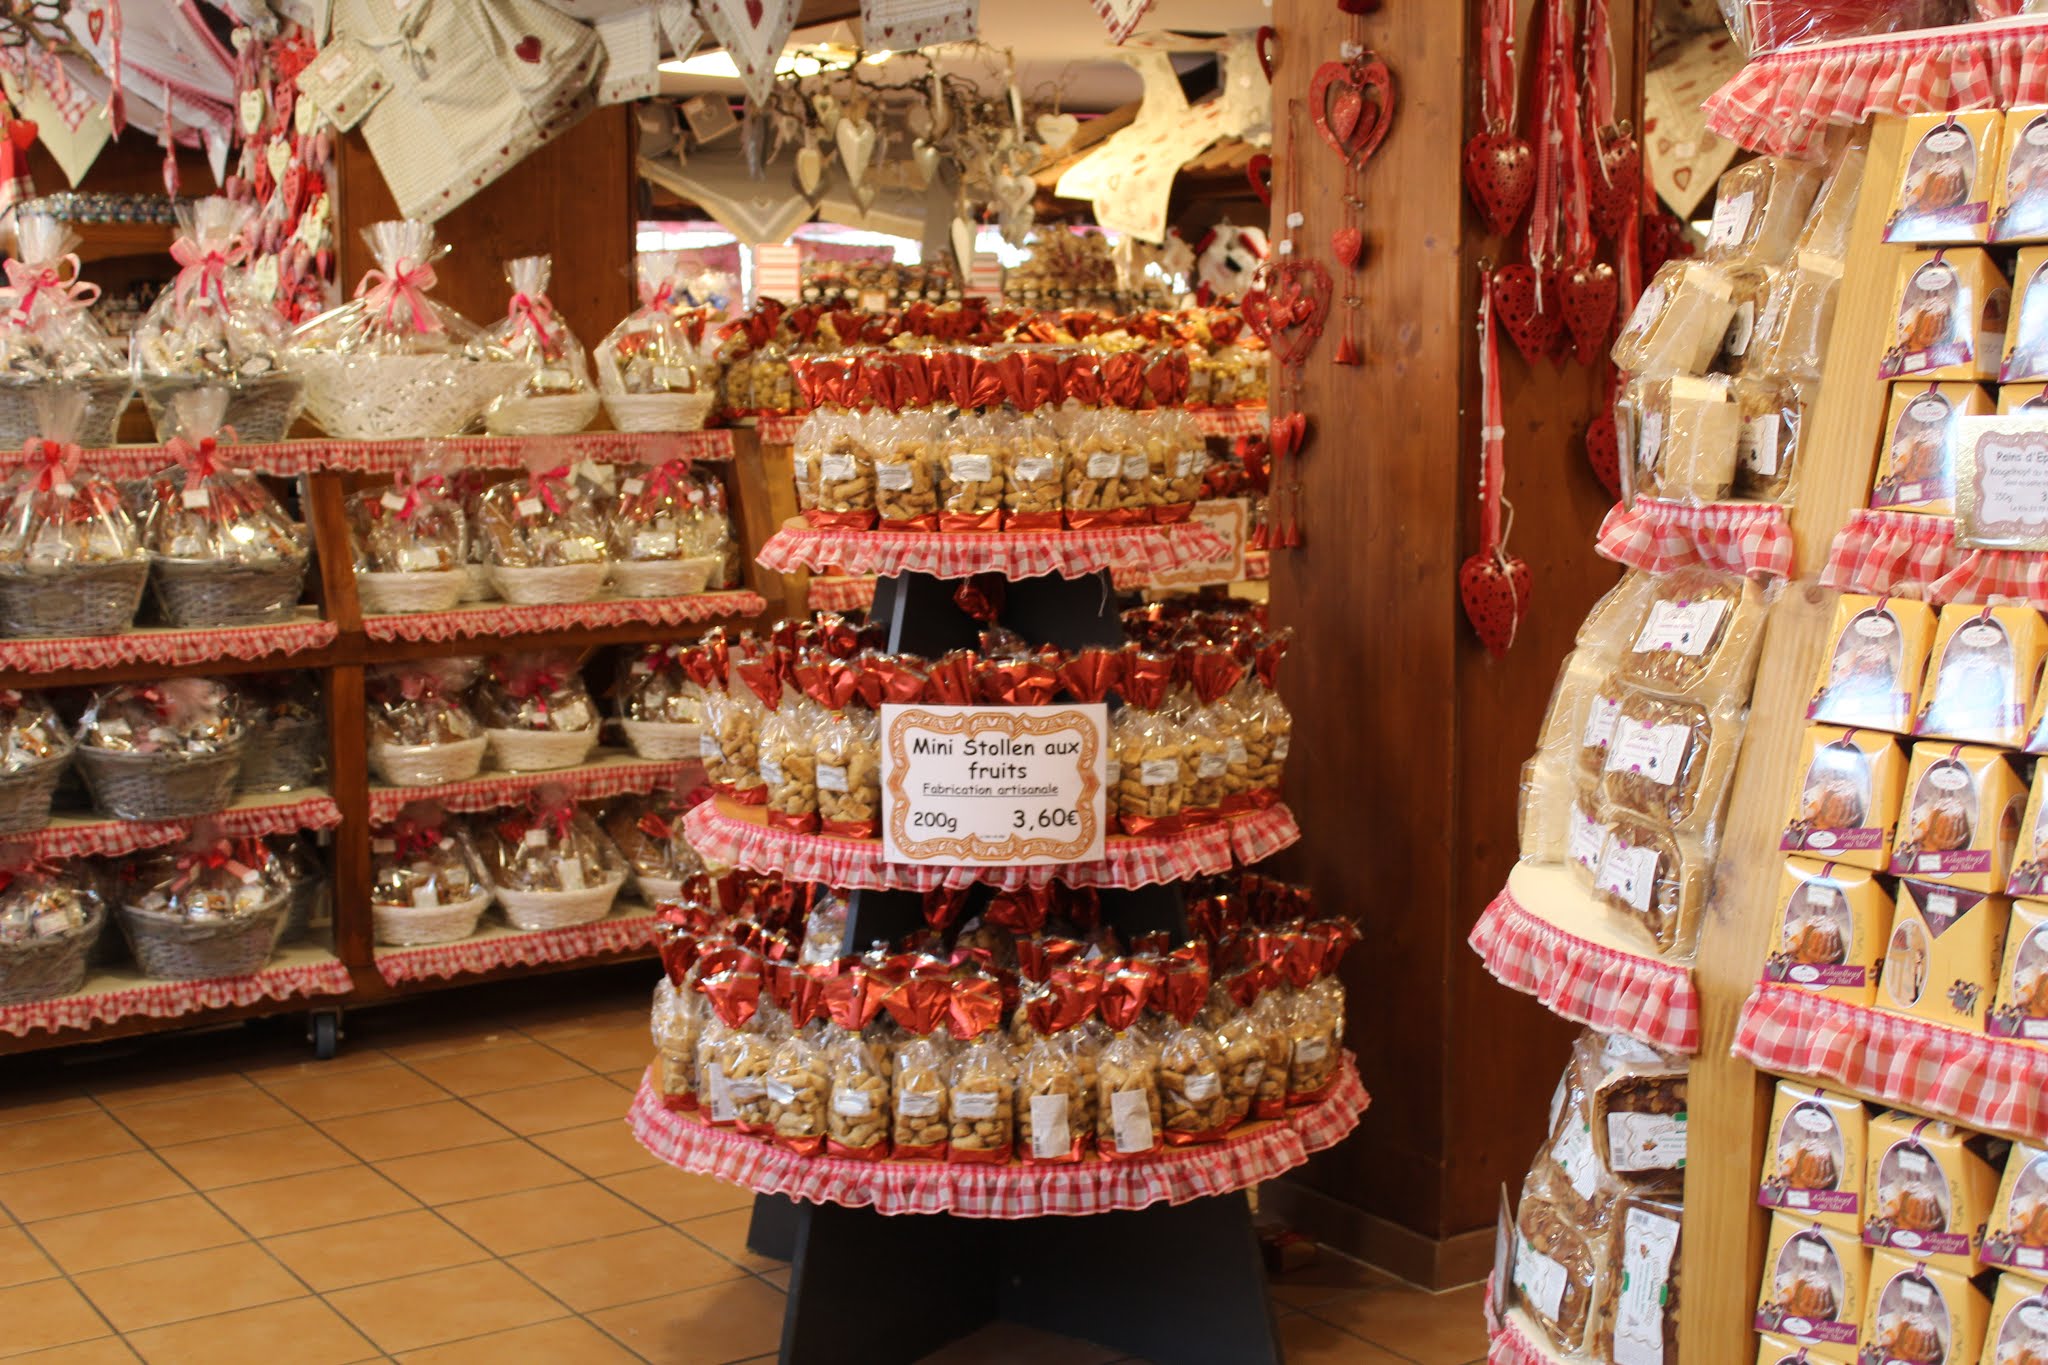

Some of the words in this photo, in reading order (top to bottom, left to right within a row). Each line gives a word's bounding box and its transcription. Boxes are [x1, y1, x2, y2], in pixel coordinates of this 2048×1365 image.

[1996, 451, 2021, 462] Pains
[913, 738, 953, 756] Mini
[963, 738, 1035, 756] Stollen
[1044, 741, 1080, 756] aux
[968, 762, 1027, 779] fruits
[923, 782, 992, 795] Fabrication
[997, 782, 1059, 795] artisanale
[914, 811, 958, 832] 200g
[1013, 809, 1079, 832] 3,60€
